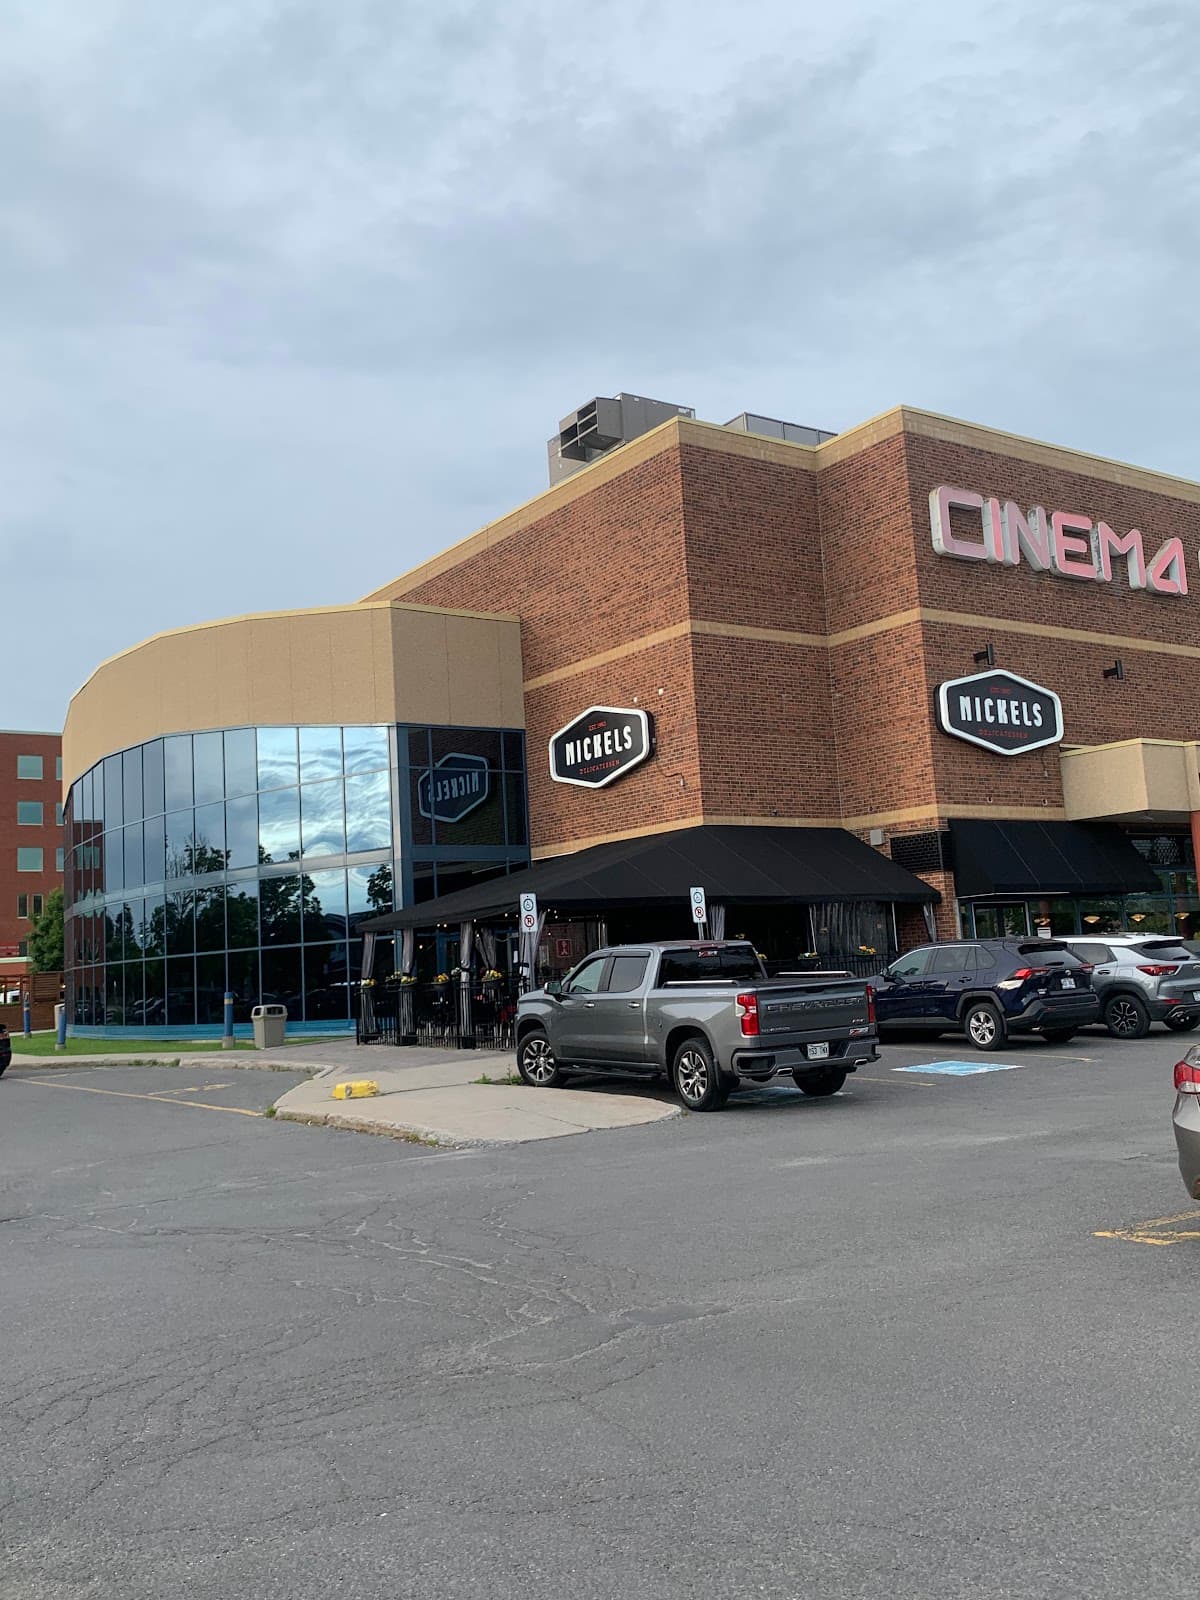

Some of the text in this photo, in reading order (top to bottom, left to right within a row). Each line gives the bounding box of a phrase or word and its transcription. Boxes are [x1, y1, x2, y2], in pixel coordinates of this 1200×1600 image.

[929, 486, 1188, 596] CINEMA
[959, 695, 1043, 727] NICKELS
[565, 725, 632, 766] NICKELS
